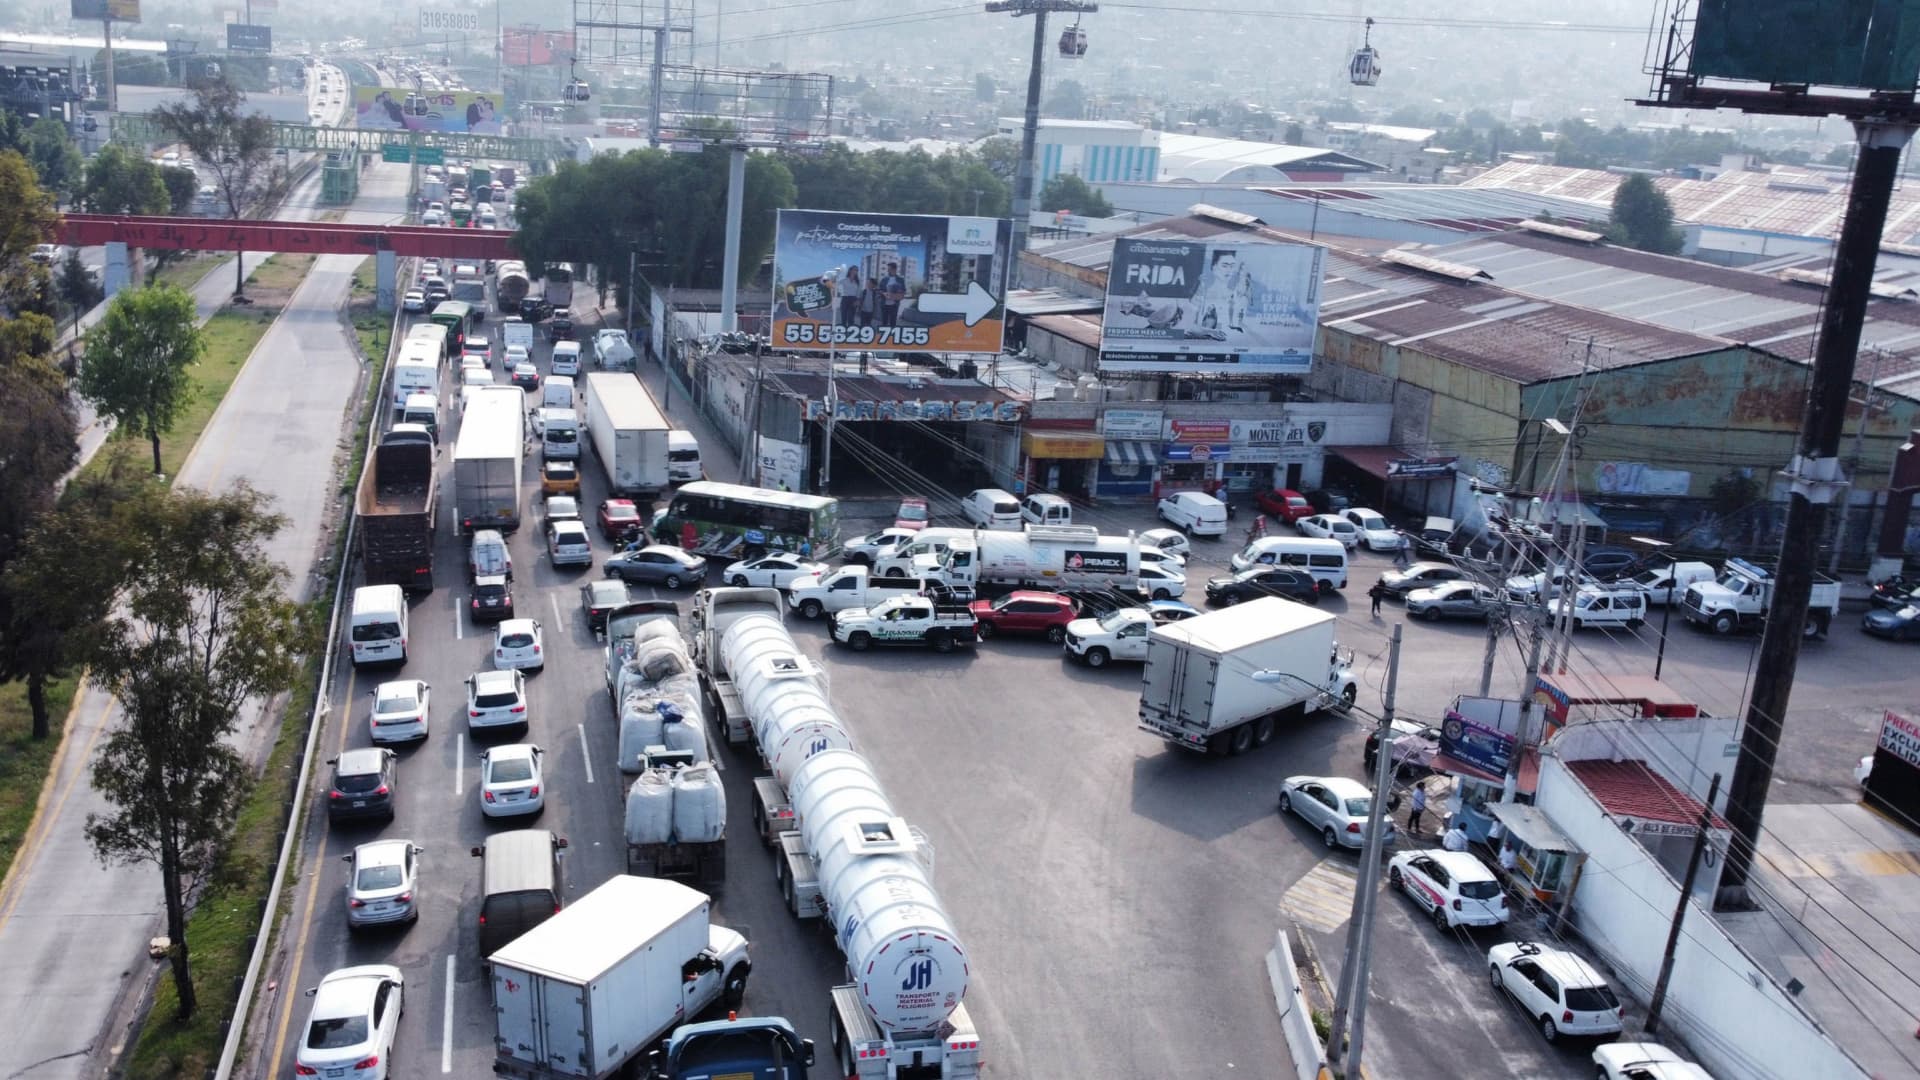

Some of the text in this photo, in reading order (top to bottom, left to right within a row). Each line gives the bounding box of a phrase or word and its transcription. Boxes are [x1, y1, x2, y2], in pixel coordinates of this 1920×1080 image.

[1126, 263, 1185, 286] FRIDA
[785, 323, 929, 345] 55 5829 7155
[1249, 428, 1305, 441] MONTEREY
[1084, 558, 1120, 567] PEMEX
[902, 959, 932, 991] JH
[896, 991, 940, 999] TRANSPORTA
